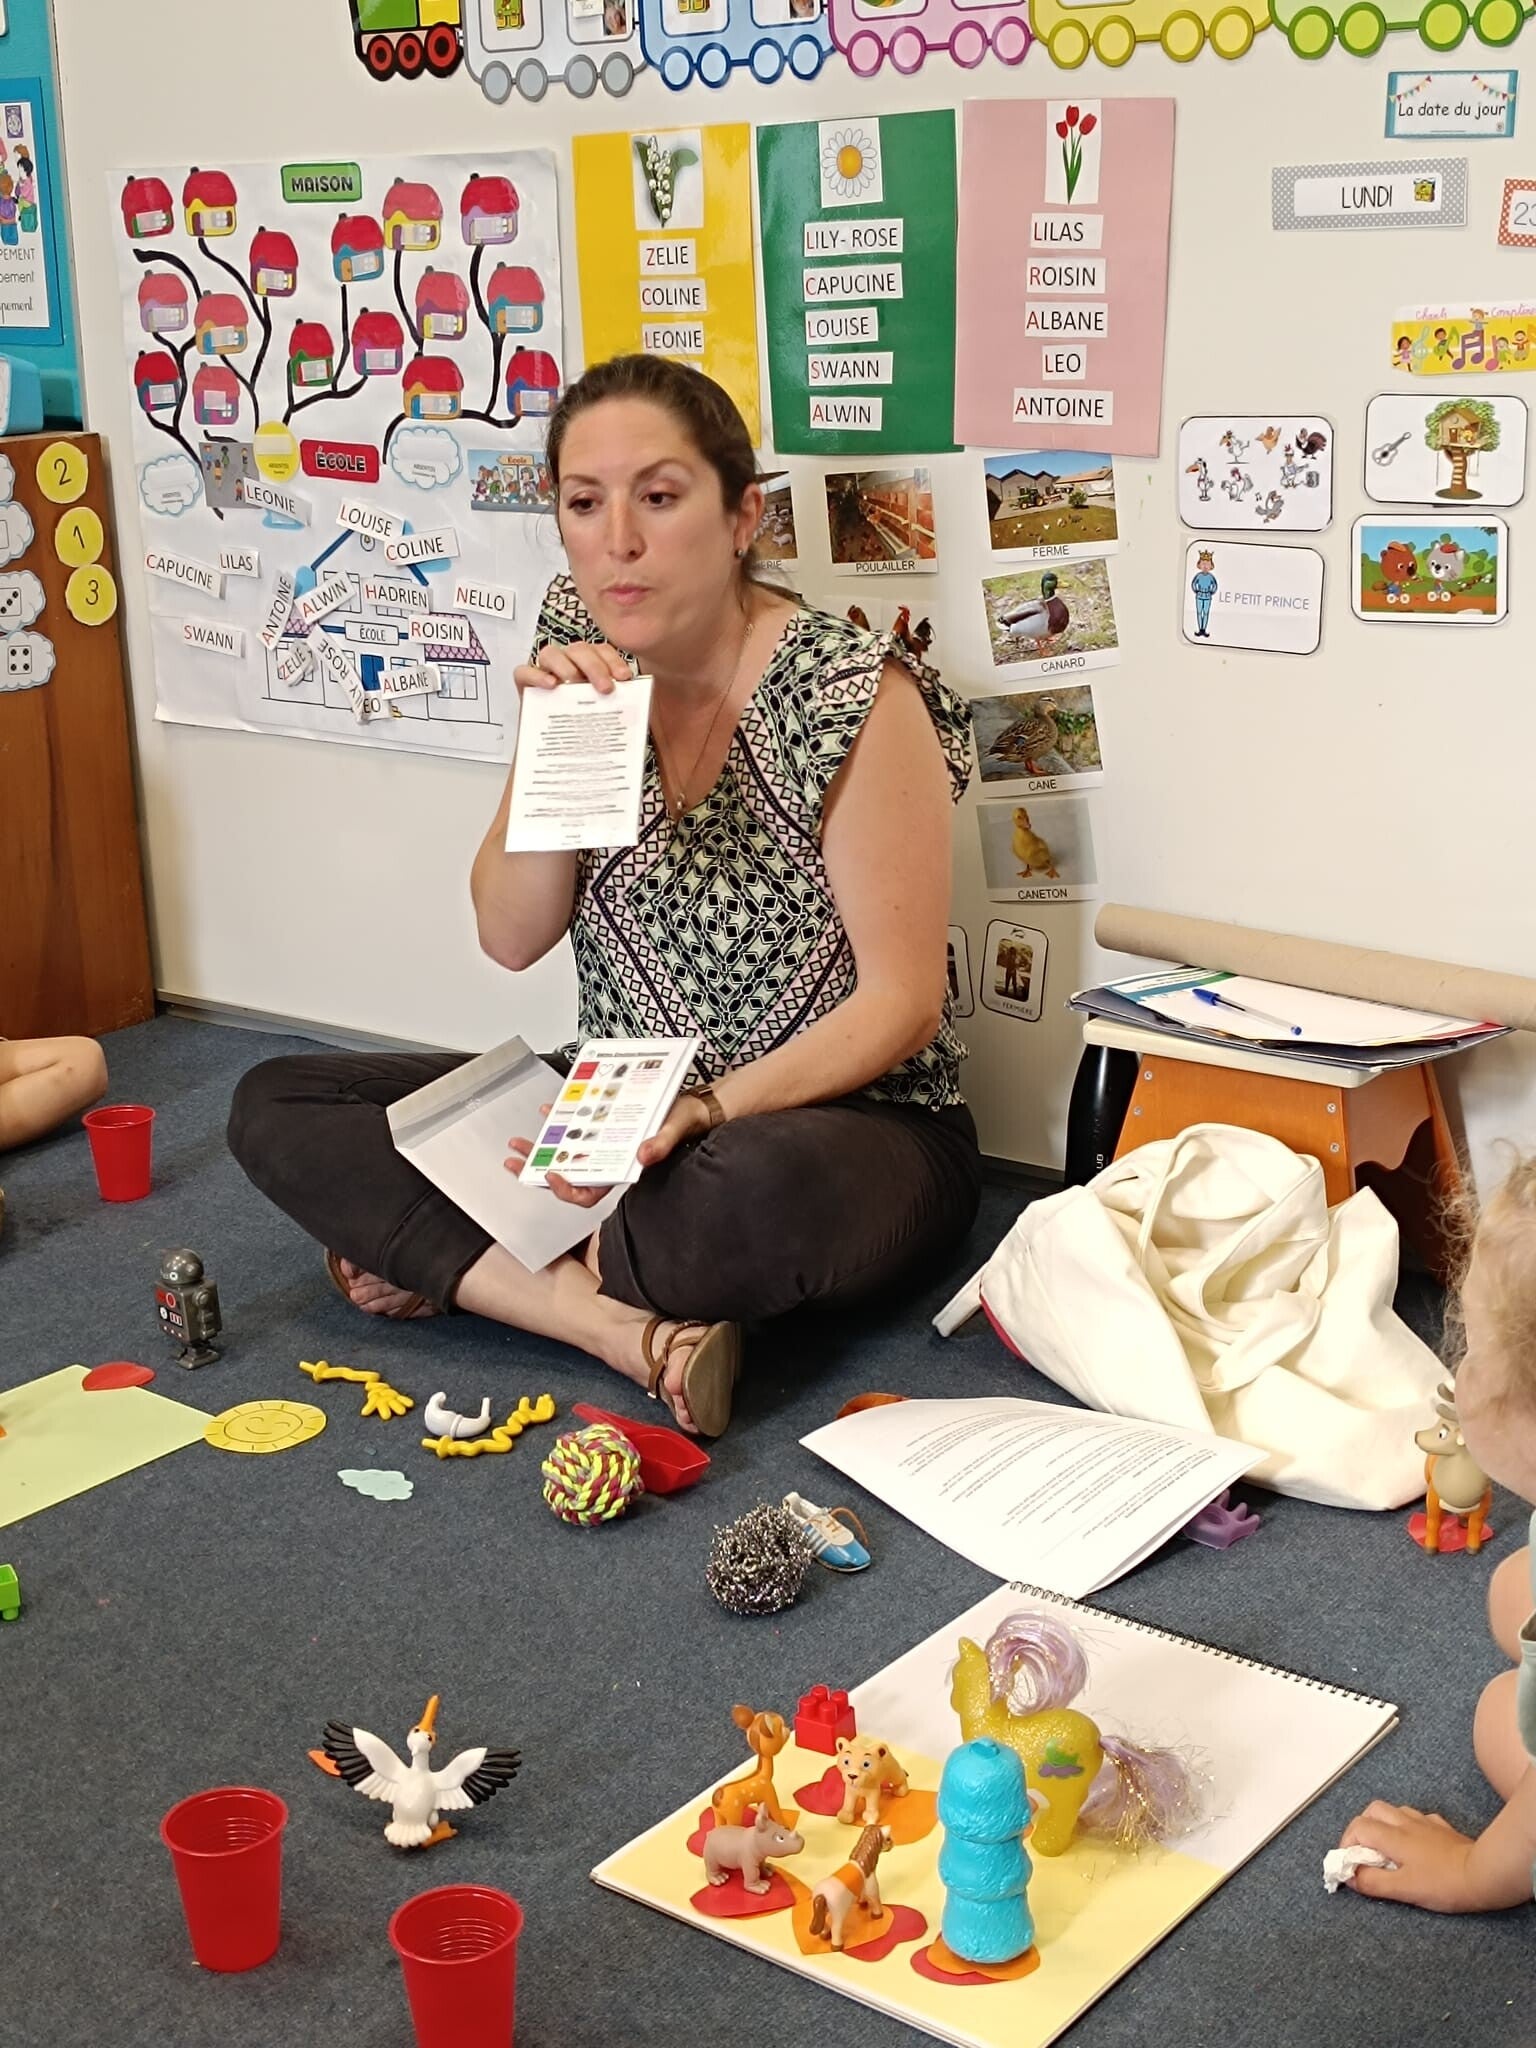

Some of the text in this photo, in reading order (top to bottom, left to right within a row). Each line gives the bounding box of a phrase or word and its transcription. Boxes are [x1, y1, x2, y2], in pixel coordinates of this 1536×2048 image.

[1398, 101, 1506, 120] La date du jour
[291, 176, 354, 194] MAISON
[1341, 185, 1393, 209] LUNDI
[1034, 222, 1084, 242] LILAS
[646, 246, 688, 266] ZELIE
[806, 273, 897, 296] CAPUCINE
[1029, 266, 1096, 287] ROISIN
[641, 287, 700, 306] COLINE
[807, 317, 870, 338] LOUISE
[1026, 310, 1105, 331] ALBANE
[644, 330, 702, 350] LEONIE
[811, 359, 880, 379] SWANN
[1045, 353, 1081, 373] LEO
[812, 403, 872, 424] ALWIN
[1015, 397, 1105, 418] ANTOINE
[315, 445, 366, 472] ÉCOLE
[54, 458, 72, 486] 2
[246, 484, 296, 514] LEONIE
[340, 506, 393, 537] LOUISE
[73, 525, 85, 549] 1
[386, 536, 444, 561] COLINE
[1032, 545, 1070, 557] FERME
[146, 554, 213, 589] CAPUCINE
[220, 552, 253, 571] LILAS
[855, 559, 915, 572] POULAILLER
[85, 579, 99, 605] 3
[302, 580, 347, 618] ALWIN
[365, 584, 427, 608] HADRIEN
[456, 587, 505, 609] NELLO
[1219, 591, 1310, 610] LE PETIT PRINCE
[262, 575, 292, 646] ANTOINE
[184, 625, 234, 650] SWANN
[360, 625, 386, 642] ÉCOLE
[412, 618, 464, 641] ROISIN
[1041, 656, 1086, 673] CANARD
[383, 672, 429, 693] ALBANE
[363, 697, 381, 714] EO
[1028, 779, 1056, 791] CANE
[1017, 888, 1068, 900] CANETON
